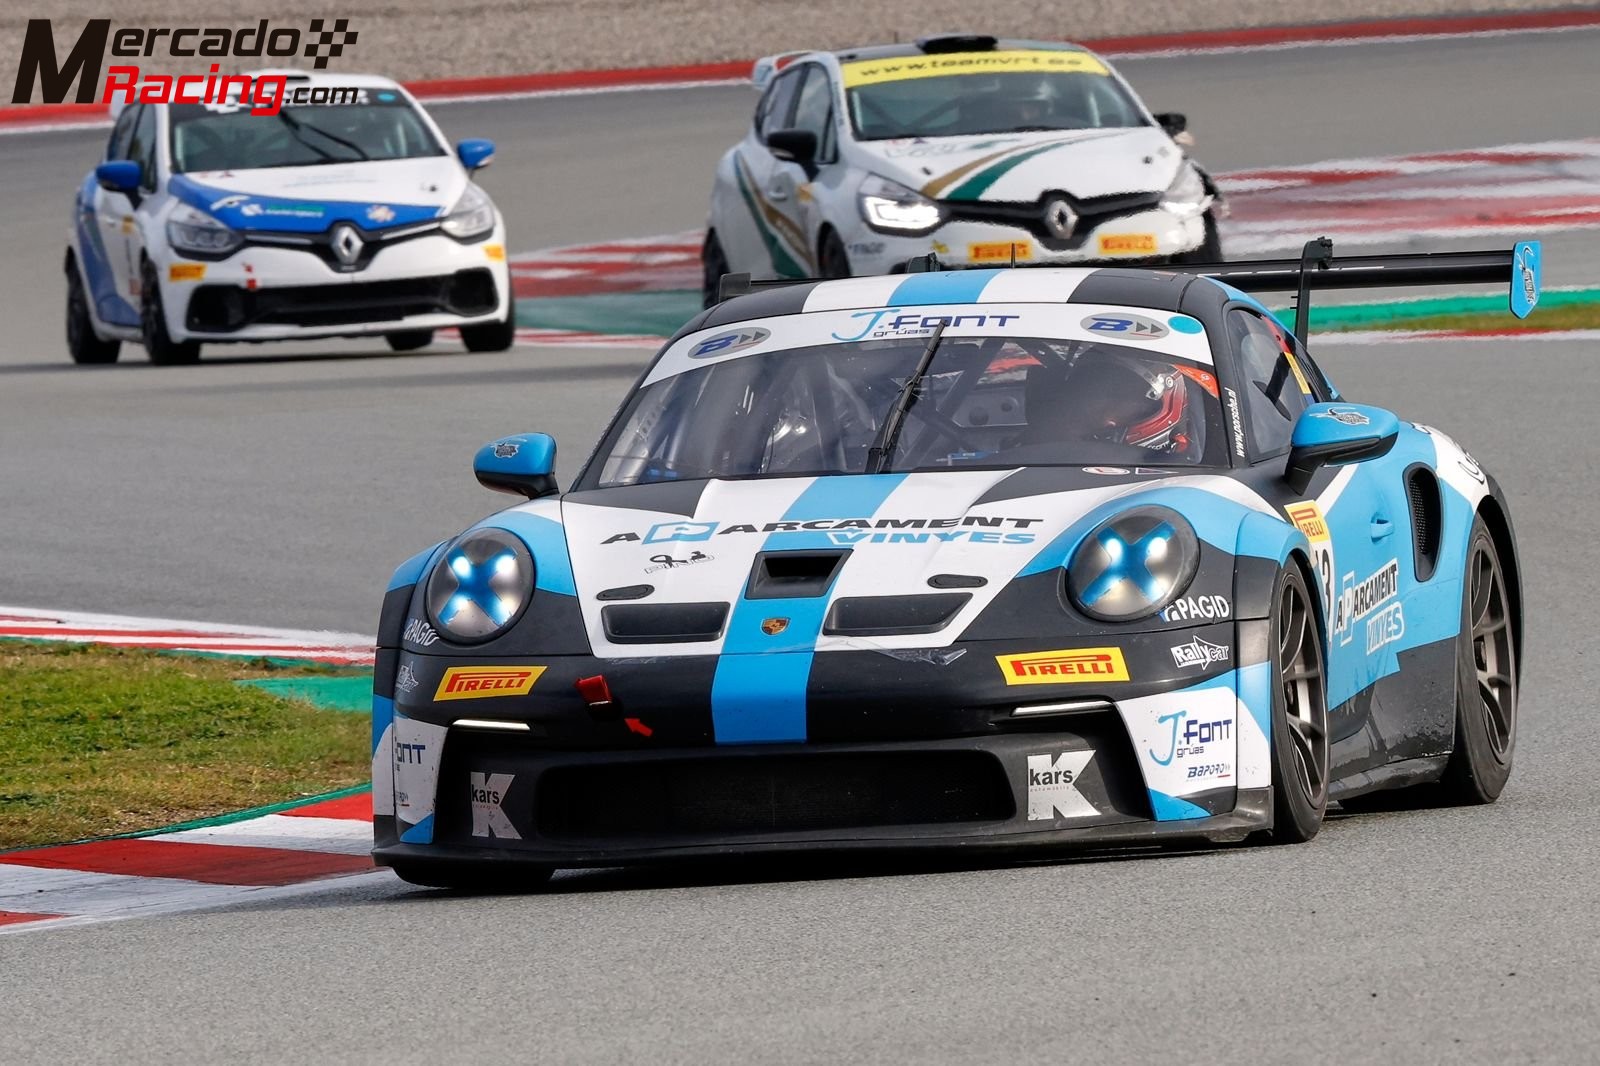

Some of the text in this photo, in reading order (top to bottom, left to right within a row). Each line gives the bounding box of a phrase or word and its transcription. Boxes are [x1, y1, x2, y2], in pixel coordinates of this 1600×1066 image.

[826, 531, 1036, 546] VINYES
[1174, 594, 1230, 620] PAGID
[1010, 653, 1113, 677] PIRELLI
[445, 671, 532, 693] PIRELLI
[1029, 768, 1074, 786] kars
[471, 783, 500, 805] kars
